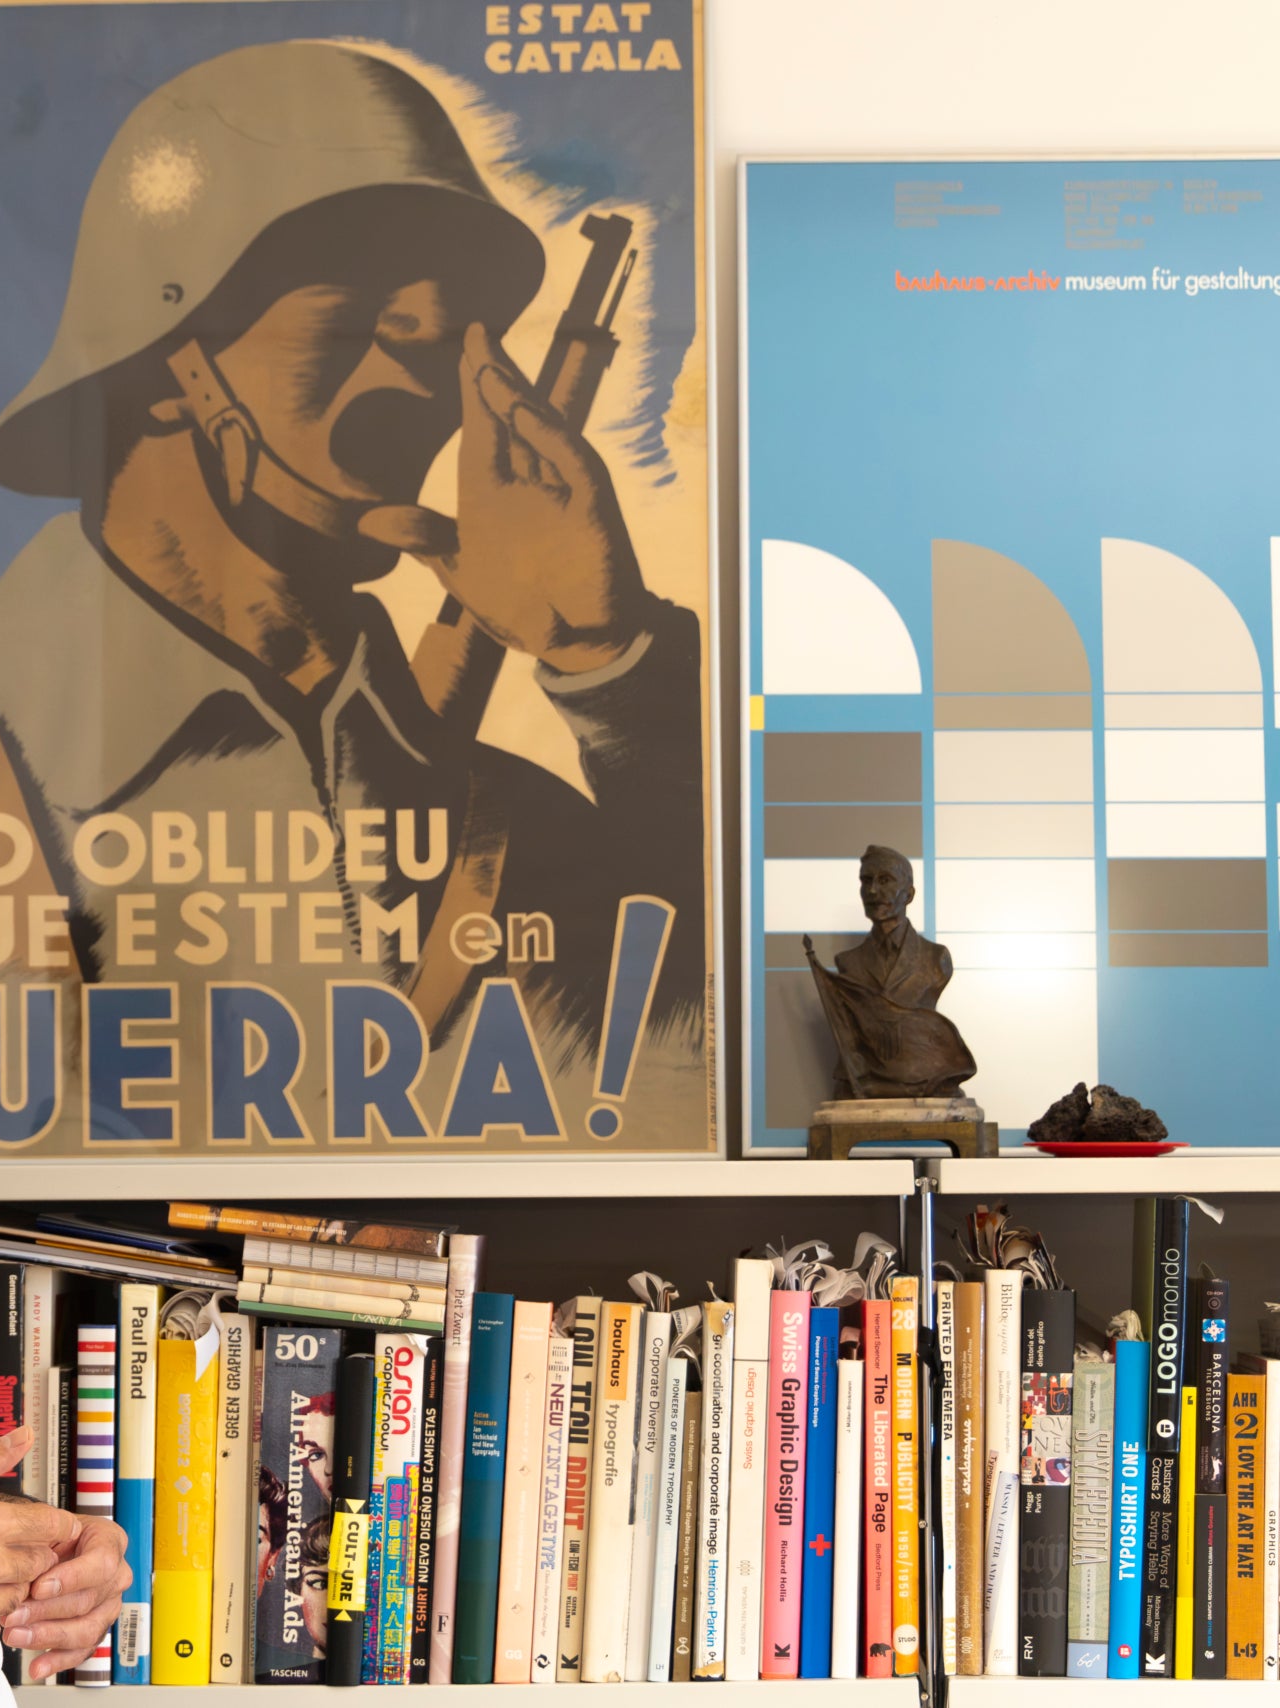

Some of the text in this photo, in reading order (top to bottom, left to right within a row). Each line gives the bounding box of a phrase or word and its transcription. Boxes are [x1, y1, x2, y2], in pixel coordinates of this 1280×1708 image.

[485, 4, 652, 35] ESTAT
[484, 39, 682, 73] CATALA
[1065, 275, 1146, 291] museum
[1152, 268, 1180, 291] für
[1184, 266, 1280, 296] gestaltung
[73, 808, 449, 887] OBLIDEU
[118, 891, 420, 967] ESTEM
[449, 910, 556, 965] en
[8, 1274, 18, 1336] Germano Celant
[33, 1294, 41, 1322] ANDY
[452, 1289, 465, 1346] Piet Zwart
[892, 1308, 915, 1330] 28
[1156, 1248, 1180, 1394] LOGOmondo
[33, 1327, 41, 1368] WARHOL
[130, 1306, 148, 1400] Paul Rand
[274, 1334, 326, 1361] 50s
[609, 1318, 627, 1388] bauhaus
[872, 1341, 881, 1370] Spencer
[1026, 1328, 1035, 1367] Historia del
[1036, 1321, 1046, 1367] diseño gráfico
[225, 1327, 241, 1439] GREEN GRAPHICS
[896, 1353, 912, 1419] MODERN
[941, 1292, 952, 1441] PRINTED EPHEMERA
[32, 1373, 40, 1407] SERIES
[549, 1383, 565, 1427] NEW
[644, 1337, 664, 1453] Corporate Diversity
[670, 1378, 680, 1419] PIONEERS
[874, 1374, 888, 1405] The
[1204, 1387, 1212, 1422] DESIGNS
[1211, 1353, 1221, 1434] BARCELONA
[32, 1411, 40, 1432] AND
[60, 1403, 68, 1475] LICHTENSTEIN
[670, 1422, 678, 1431] OF
[688, 1419, 696, 1443] Eckhard
[743, 1368, 756, 1470] Swiss Graphic Design
[774, 1312, 803, 1527] Swiss Graphic Design
[1233, 1412, 1259, 1440] 2
[602, 1404, 621, 1487] typografie
[668, 1434, 678, 1469] MODERN
[687, 1444, 695, 1472] Neumann
[873, 1410, 888, 1487] Liberated
[958, 1418, 977, 1496] arabesque
[543, 1430, 562, 1534] VINTAGE
[896, 1432, 913, 1513] PUBLICITY
[1150, 1458, 1162, 1500] Cards 2
[1162, 1458, 1174, 1504] Business
[665, 1472, 675, 1526] TYPOGRAPHY
[685, 1480, 693, 1511] Functional
[706, 1353, 723, 1647] coordination and corporate image Henrion+Parkin
[871, 1492, 888, 1533] Page
[999, 1483, 1013, 1516] MASSIN
[1025, 1491, 1034, 1513] Meggs
[1034, 1493, 1042, 1513] Purvis
[1071, 1430, 1111, 1566] STYLEPEDIA
[1119, 1441, 1139, 1581] TYPOSHIRT ONE
[1237, 1446, 1254, 1579] LOVE THE ART HATE
[282, 1390, 311, 1644] All-American Ads
[414, 1408, 436, 1634] T-SHIRT NUEVO DISEÑO DE CAMISETAS
[683, 1512, 692, 1535] Graphic
[540, 1535, 557, 1570] TYPE
[682, 1536, 691, 1556] Design
[874, 1543, 882, 1569] Bedford
[992, 1523, 1006, 1558] LETTER
[1147, 1511, 1160, 1581] Saying Hello
[1157, 1511, 1172, 1589] More Ways of
[1268, 1510, 1276, 1567] GRAPHICS
[339, 1520, 360, 1602] CULT-URE
[567, 1539, 580, 1591] LOW-TECH PRINT
[778, 1540, 788, 1603] Richard Hollis
[874, 1571, 882, 1591] Press
[988, 1562, 999, 1581] AND
[1145, 1606, 1153, 1627] Farrelly
[1152, 1595, 1161, 1643] Michael Dorrian
[413, 1658, 426, 1666] GG
[561, 1654, 579, 1670] K
[774, 1644, 791, 1658] K
[945, 1621, 956, 1664] FABER
[1024, 1636, 1034, 1660] RM
[1145, 1653, 1165, 1672] K
[1233, 1643, 1258, 1659] L-13
[269, 1669, 308, 1679] TASCHEN
